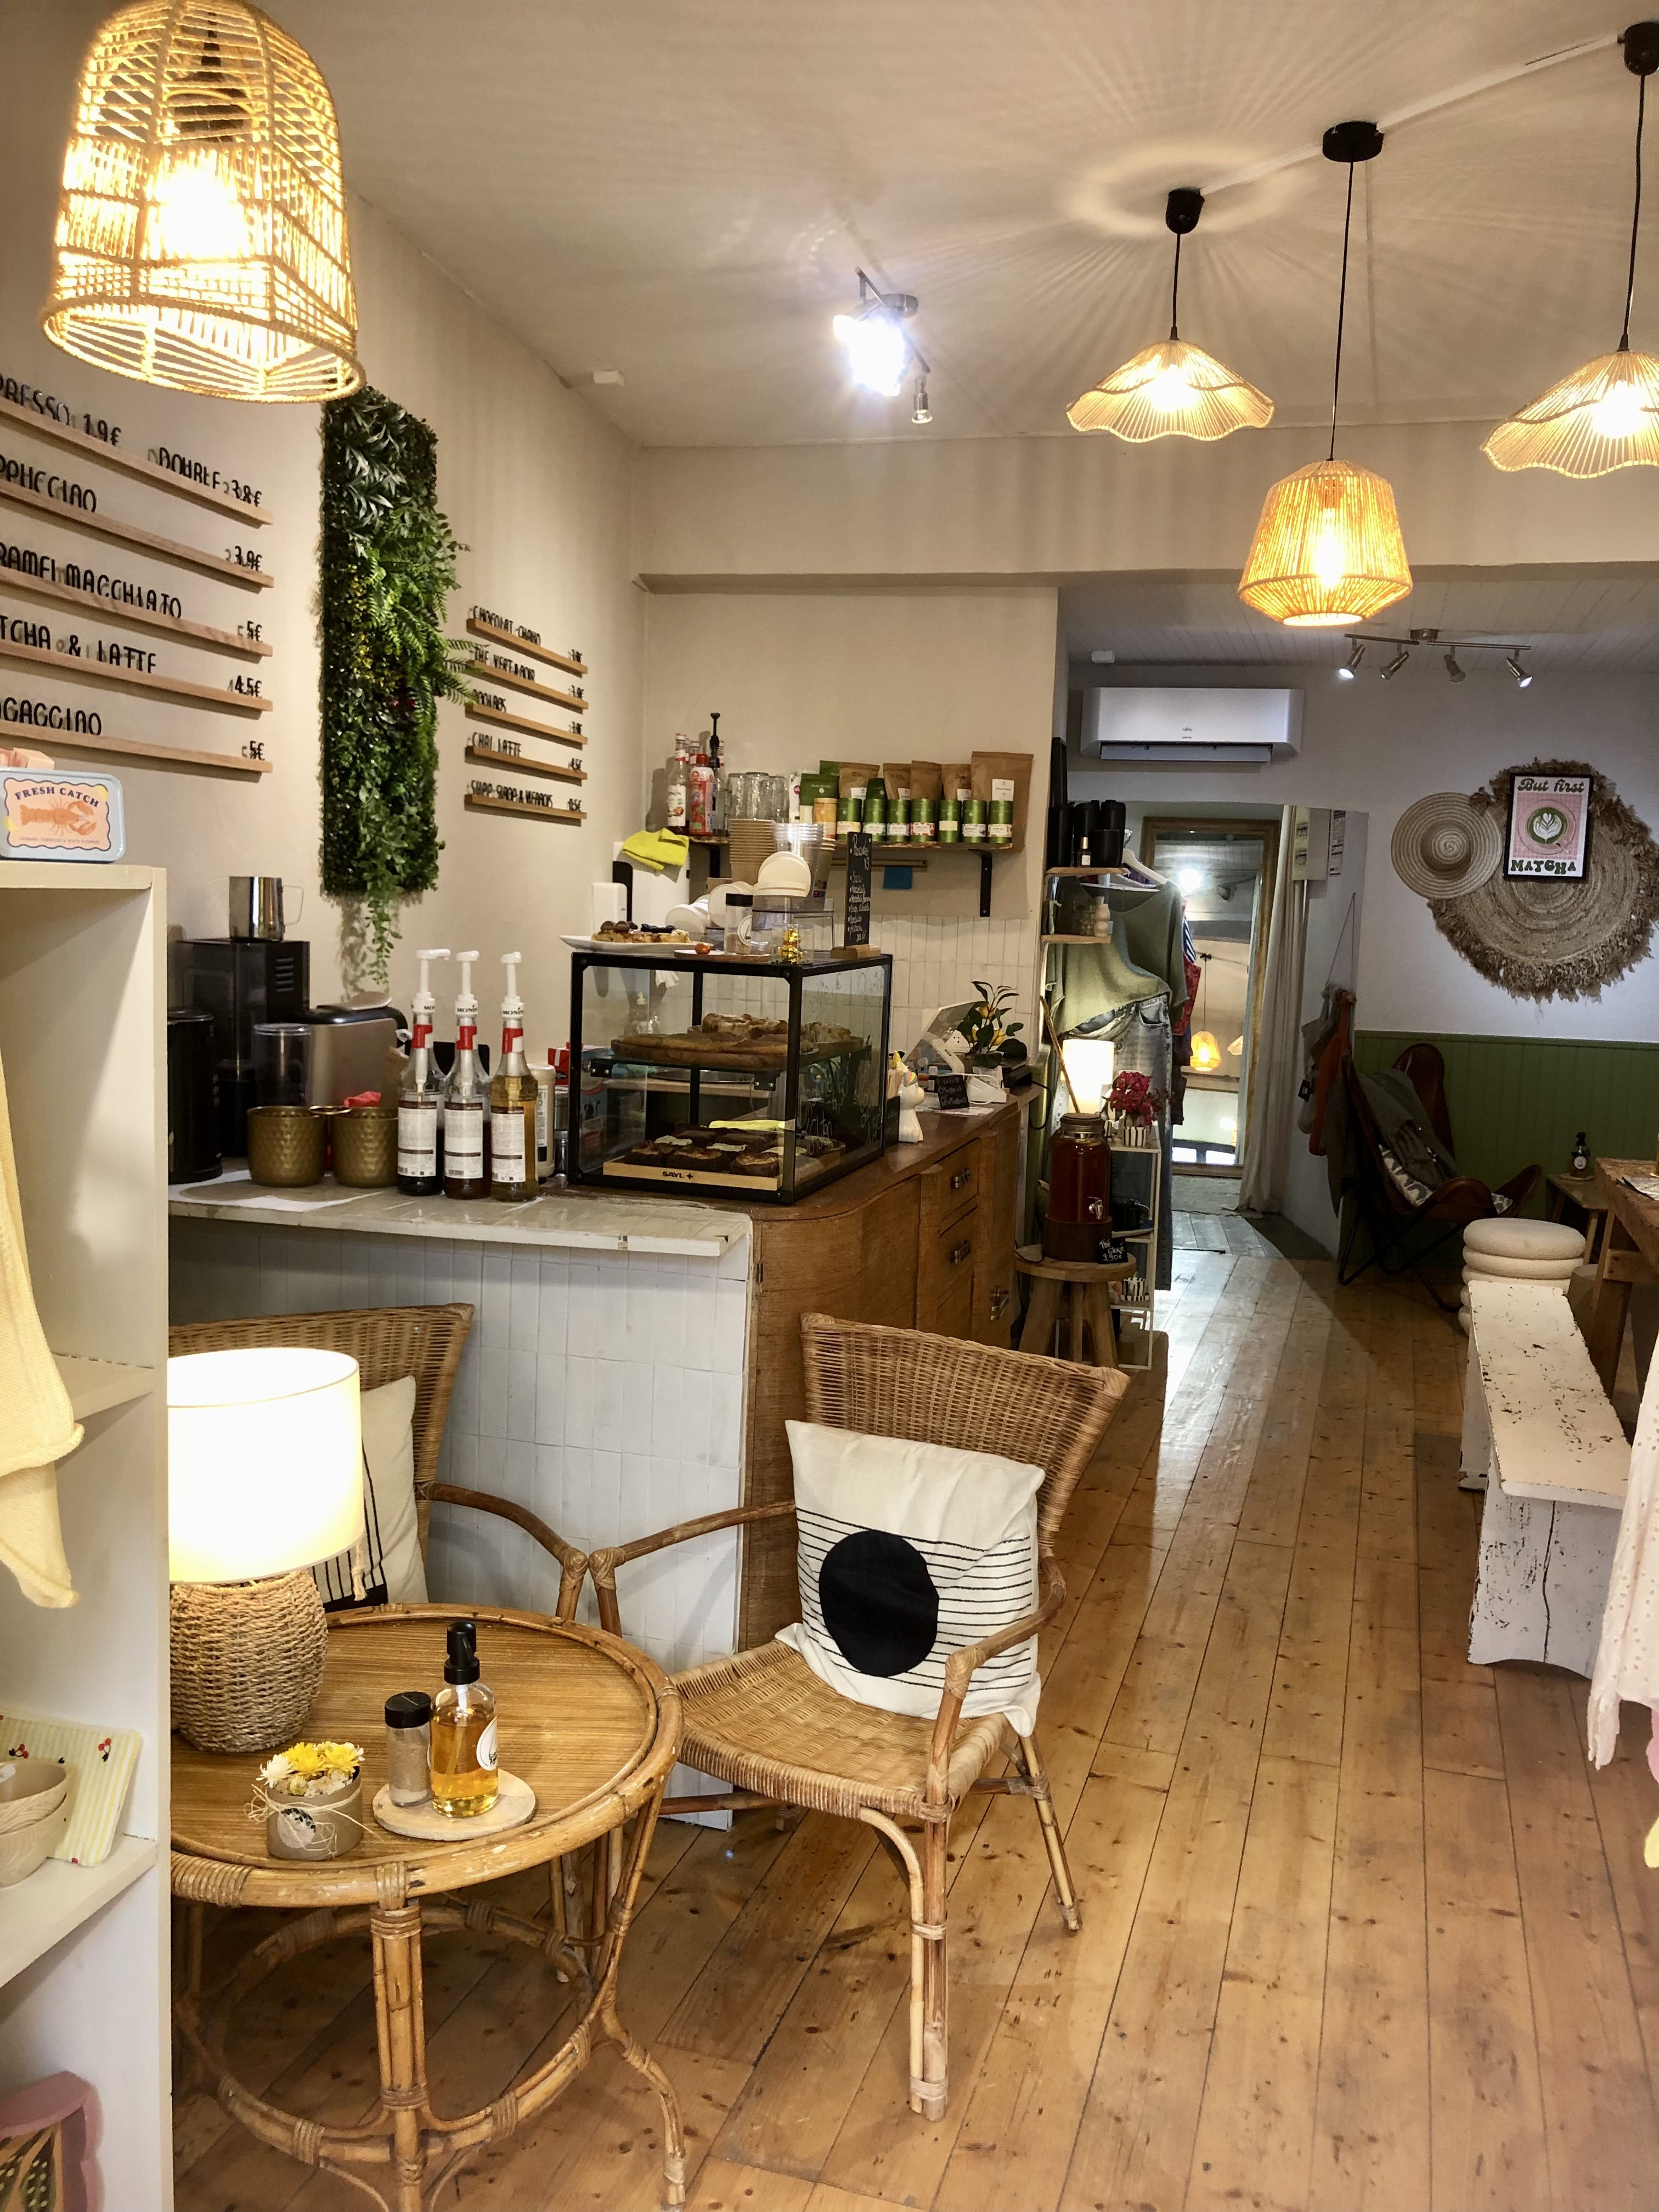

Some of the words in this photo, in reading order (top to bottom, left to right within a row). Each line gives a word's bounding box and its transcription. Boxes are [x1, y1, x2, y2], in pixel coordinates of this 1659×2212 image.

[66, 563, 182, 619] MACCHIATO
[69, 635, 81, 657] &
[0, 697, 102, 735] CACCINO
[1517, 777, 1550, 792] But
[1554, 778, 1585, 793] first
[15, 786, 55, 800] FRESH
[59, 787, 99, 808] CATCH
[1510, 859, 1577, 875] MATCHA
[662, 1171, 685, 1179] SAYL
